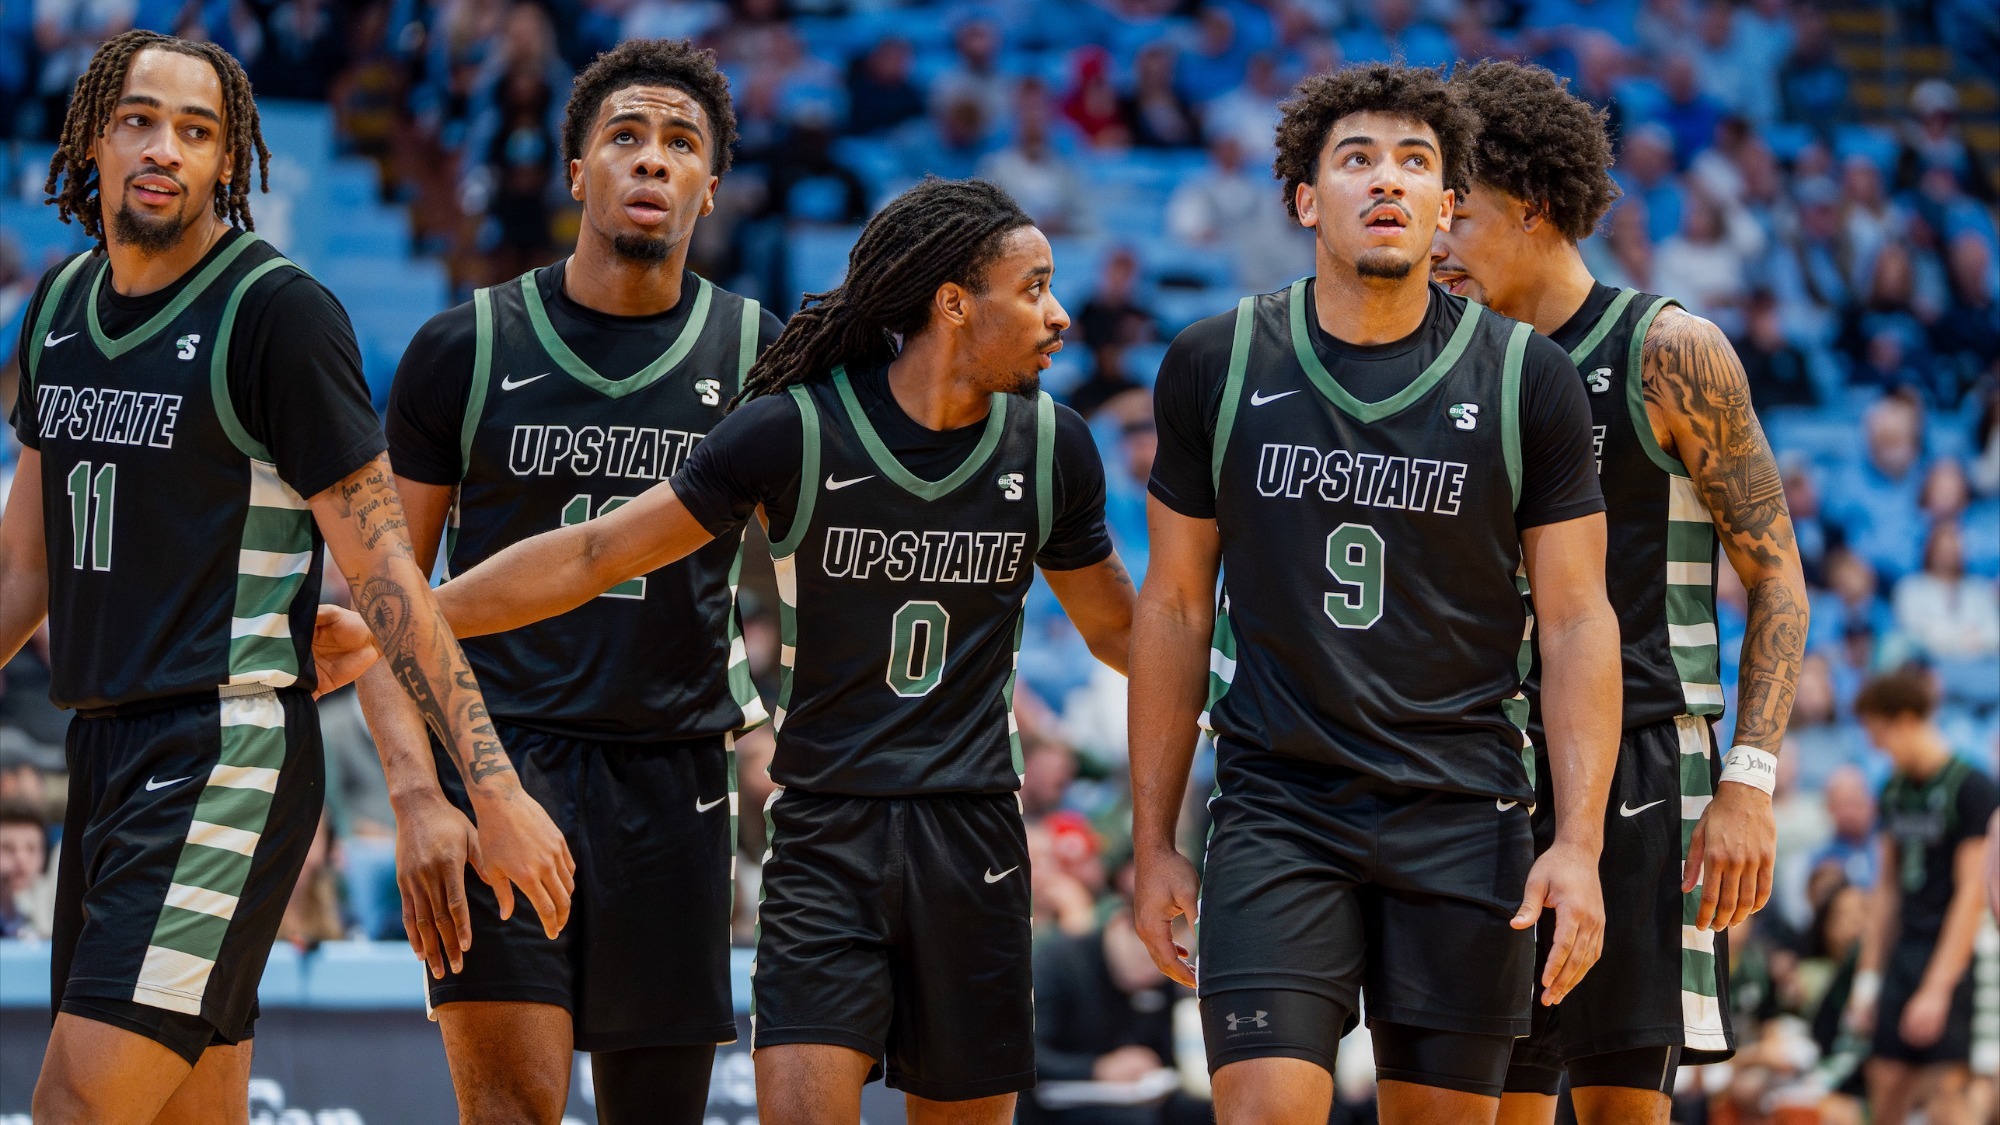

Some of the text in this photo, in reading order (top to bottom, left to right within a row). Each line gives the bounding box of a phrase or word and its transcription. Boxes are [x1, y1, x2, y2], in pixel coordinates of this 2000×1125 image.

[701, 379, 720, 405] S
[1591, 367, 1612, 393] S
[36, 384, 183, 449] UPSTATE
[1449, 403, 1479, 430] BIG S
[366, 471, 383, 485] not
[1004, 473, 1024, 500] S
[1256, 443, 1468, 516] UPSTATE
[67, 460, 117, 572] 11
[822, 526, 1026, 584] UPSTATE
[1323, 522, 1386, 630] 9
[885, 600, 951, 698] 0
